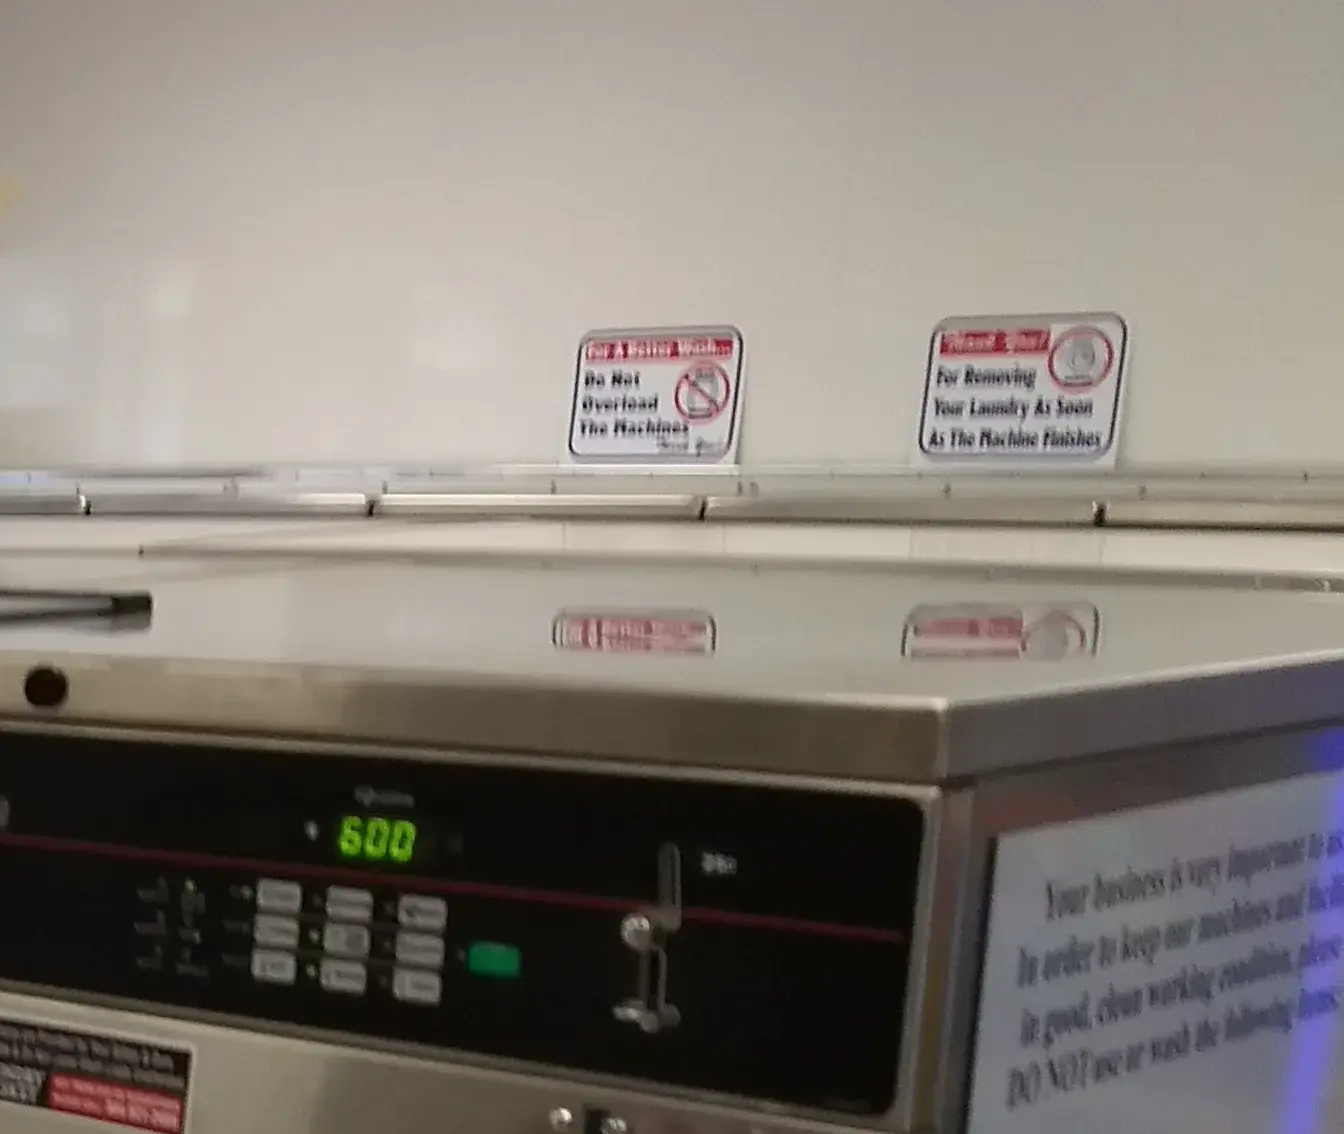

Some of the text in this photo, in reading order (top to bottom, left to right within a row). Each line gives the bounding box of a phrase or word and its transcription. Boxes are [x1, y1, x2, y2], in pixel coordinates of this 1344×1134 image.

[584, 369, 640, 388] Do Not
[937, 362, 1037, 390] For Removing
[582, 393, 658, 413] Overload
[934, 396, 1093, 423] Your Laundry As Soon
[580, 417, 689, 437] The Machines
[928, 425, 1102, 447] As The Machine Finishes
[338, 815, 416, 861] 600
